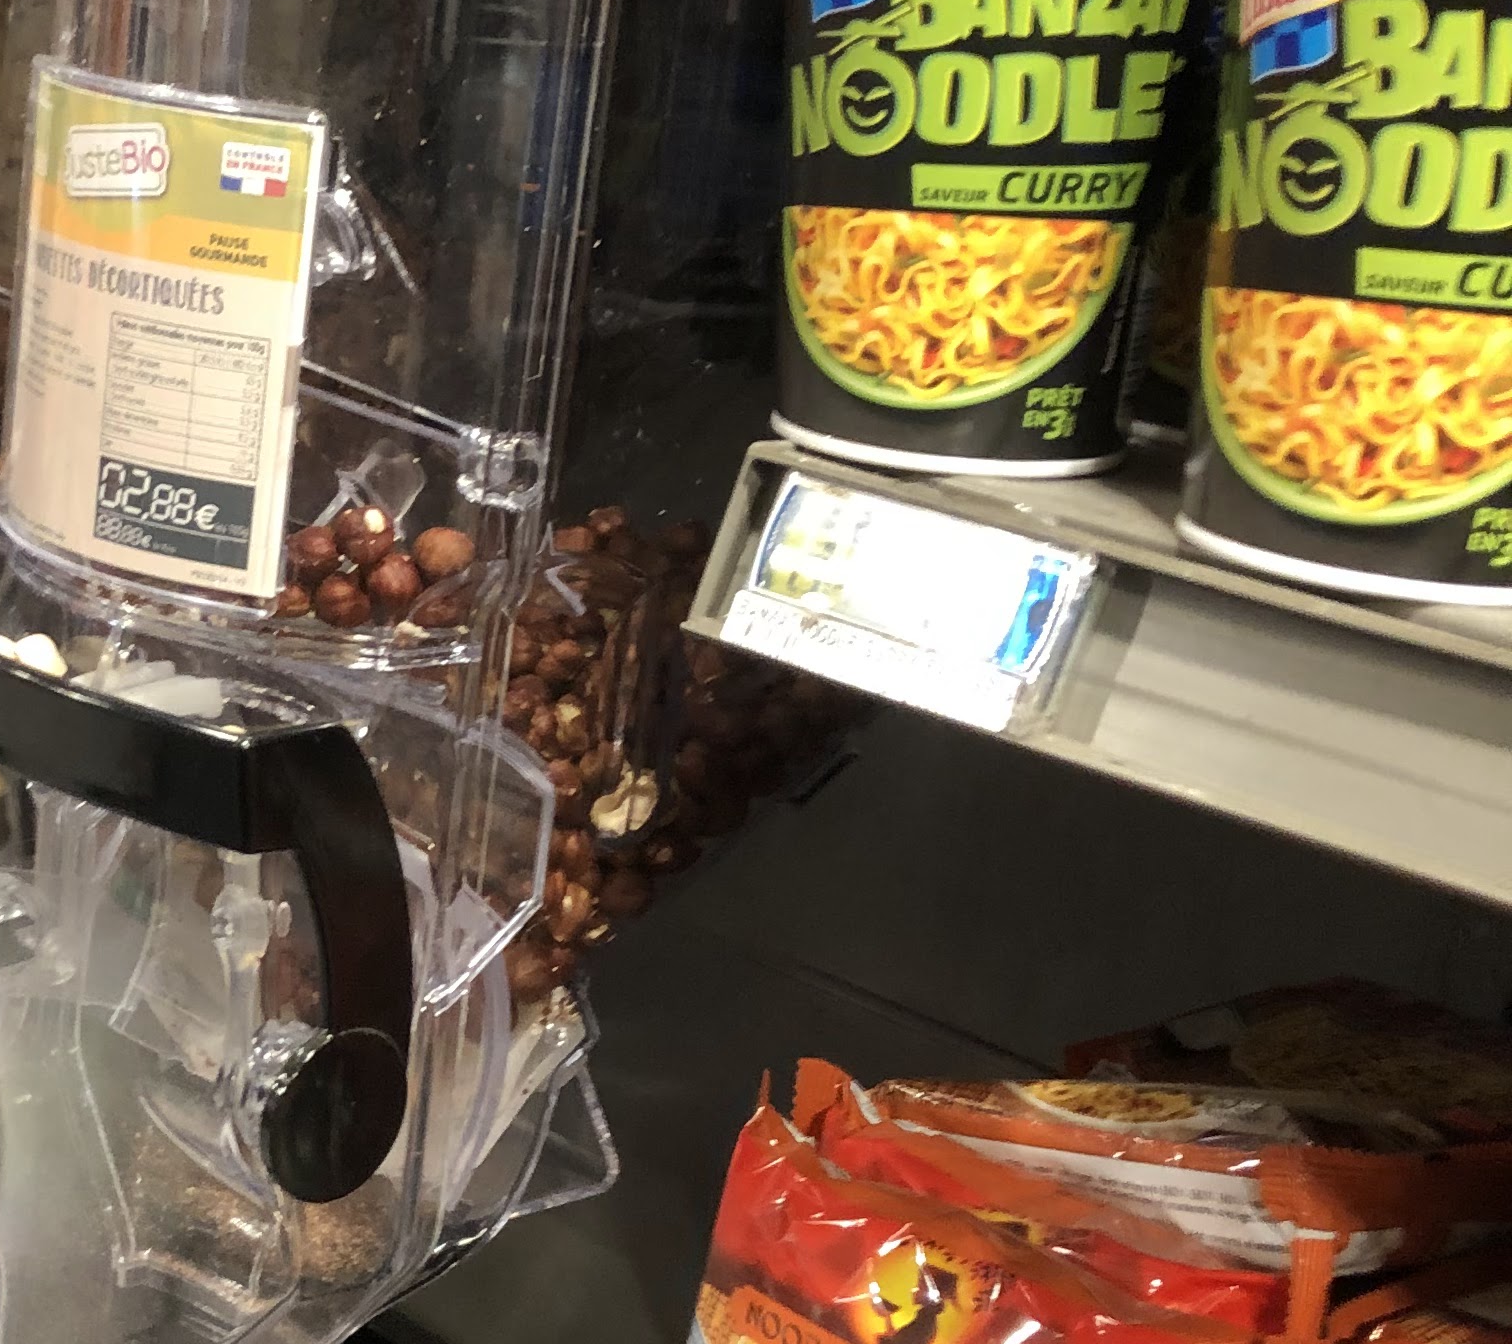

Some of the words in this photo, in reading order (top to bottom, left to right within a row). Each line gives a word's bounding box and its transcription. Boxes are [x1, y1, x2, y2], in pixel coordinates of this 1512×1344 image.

[791, 42, 1178, 157] NOODLE
[920, 187, 989, 203] SAVEUR
[997, 171, 1141, 205] CURRY
[209, 232, 250, 251] PAUSE
[189, 245, 268, 268] GOURMANDE
[88, 259, 225, 316] DÉCORTIQUÉES
[1363, 273, 1446, 295] SAVEUR
